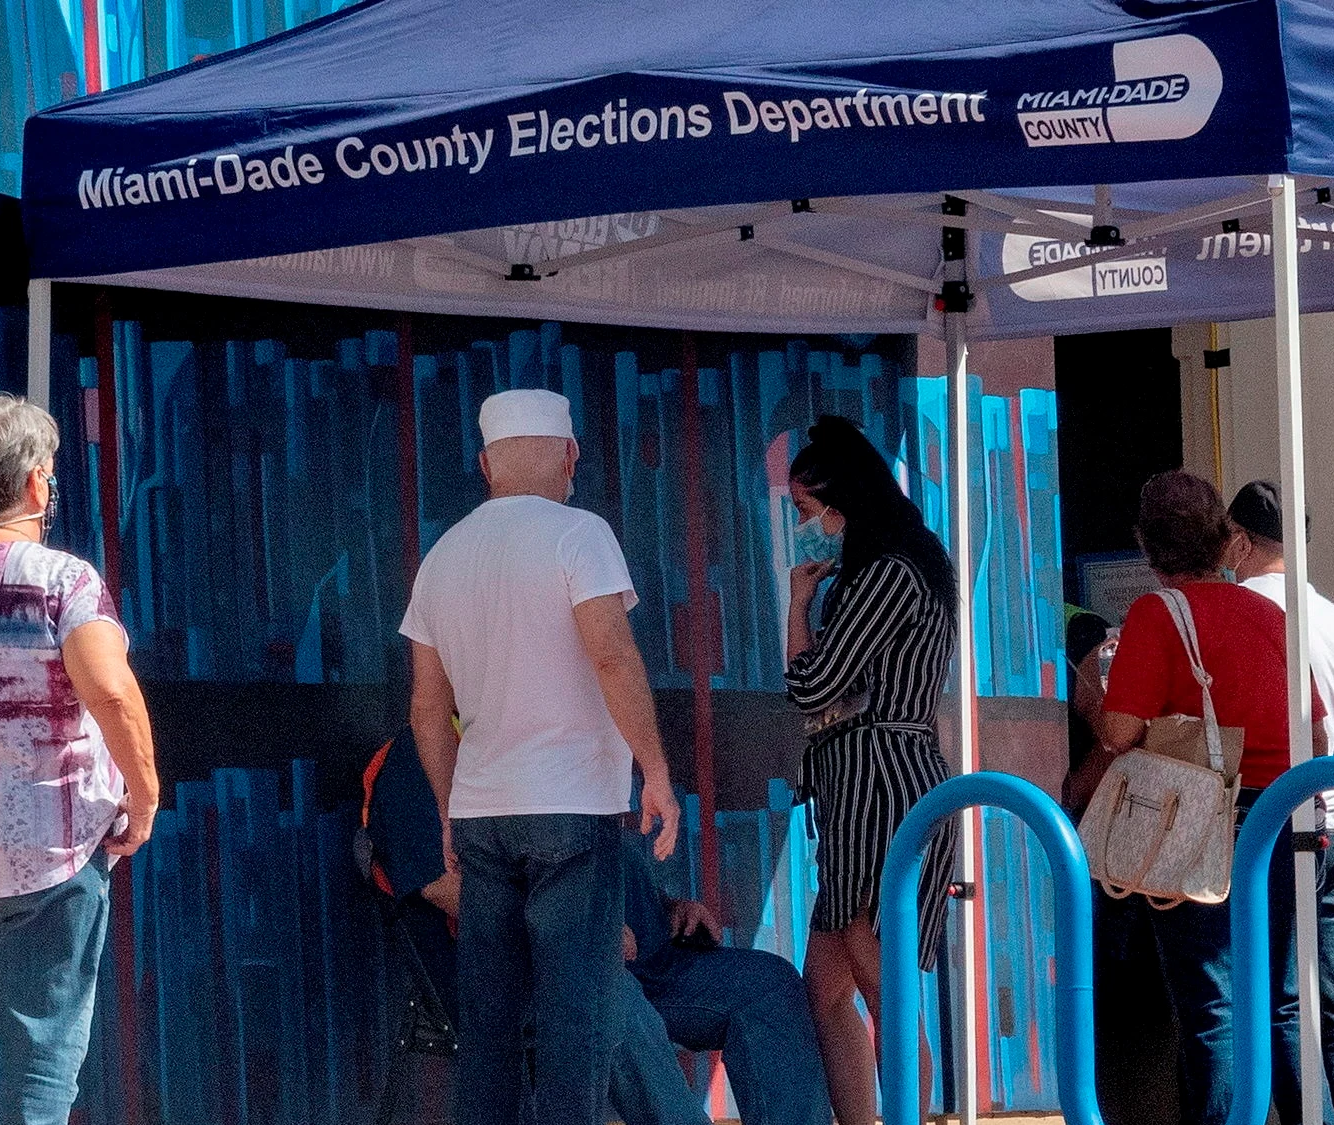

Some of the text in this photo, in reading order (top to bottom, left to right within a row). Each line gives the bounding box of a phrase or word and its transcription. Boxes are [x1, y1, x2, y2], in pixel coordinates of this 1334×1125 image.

[78, 87, 988, 210] Miami-Dade County Elections Department
[1025, 109, 1105, 142] COUNTY
